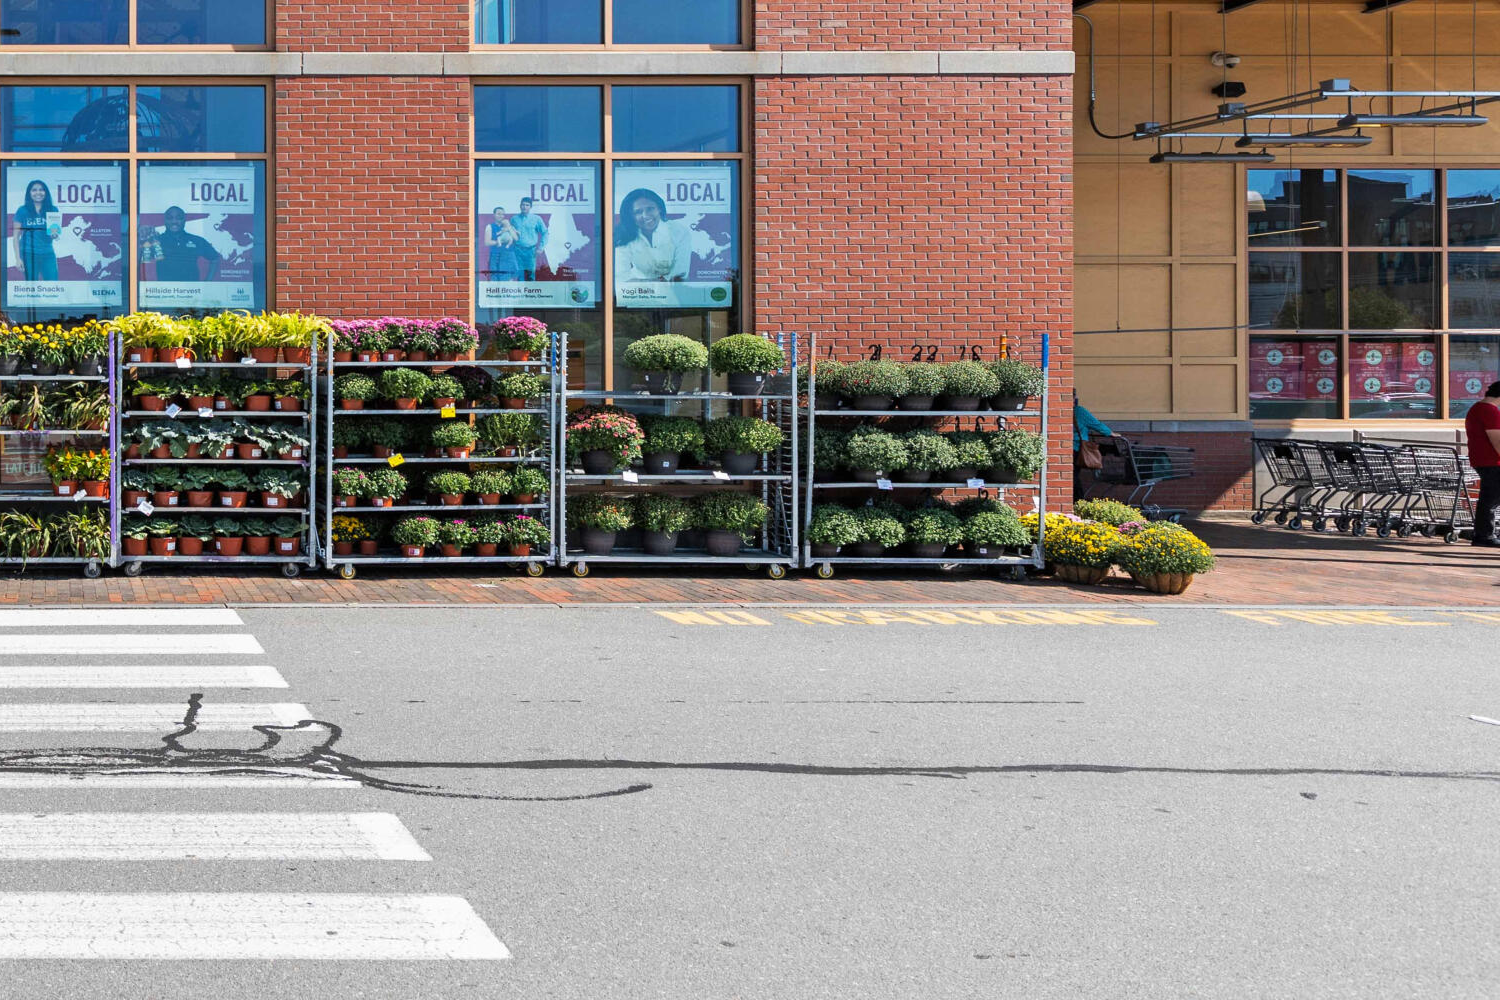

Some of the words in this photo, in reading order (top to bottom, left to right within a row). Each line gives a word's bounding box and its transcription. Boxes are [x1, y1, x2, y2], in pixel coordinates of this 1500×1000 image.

[57, 184, 116, 204] LOCAL
[190, 182, 249, 202] LOCAL
[530, 183, 589, 203] LOCAL
[666, 182, 725, 202] LOCAL
[13, 285, 35, 293] Biena
[36, 285, 65, 293] Snacks
[620, 287, 637, 296] Yogi
